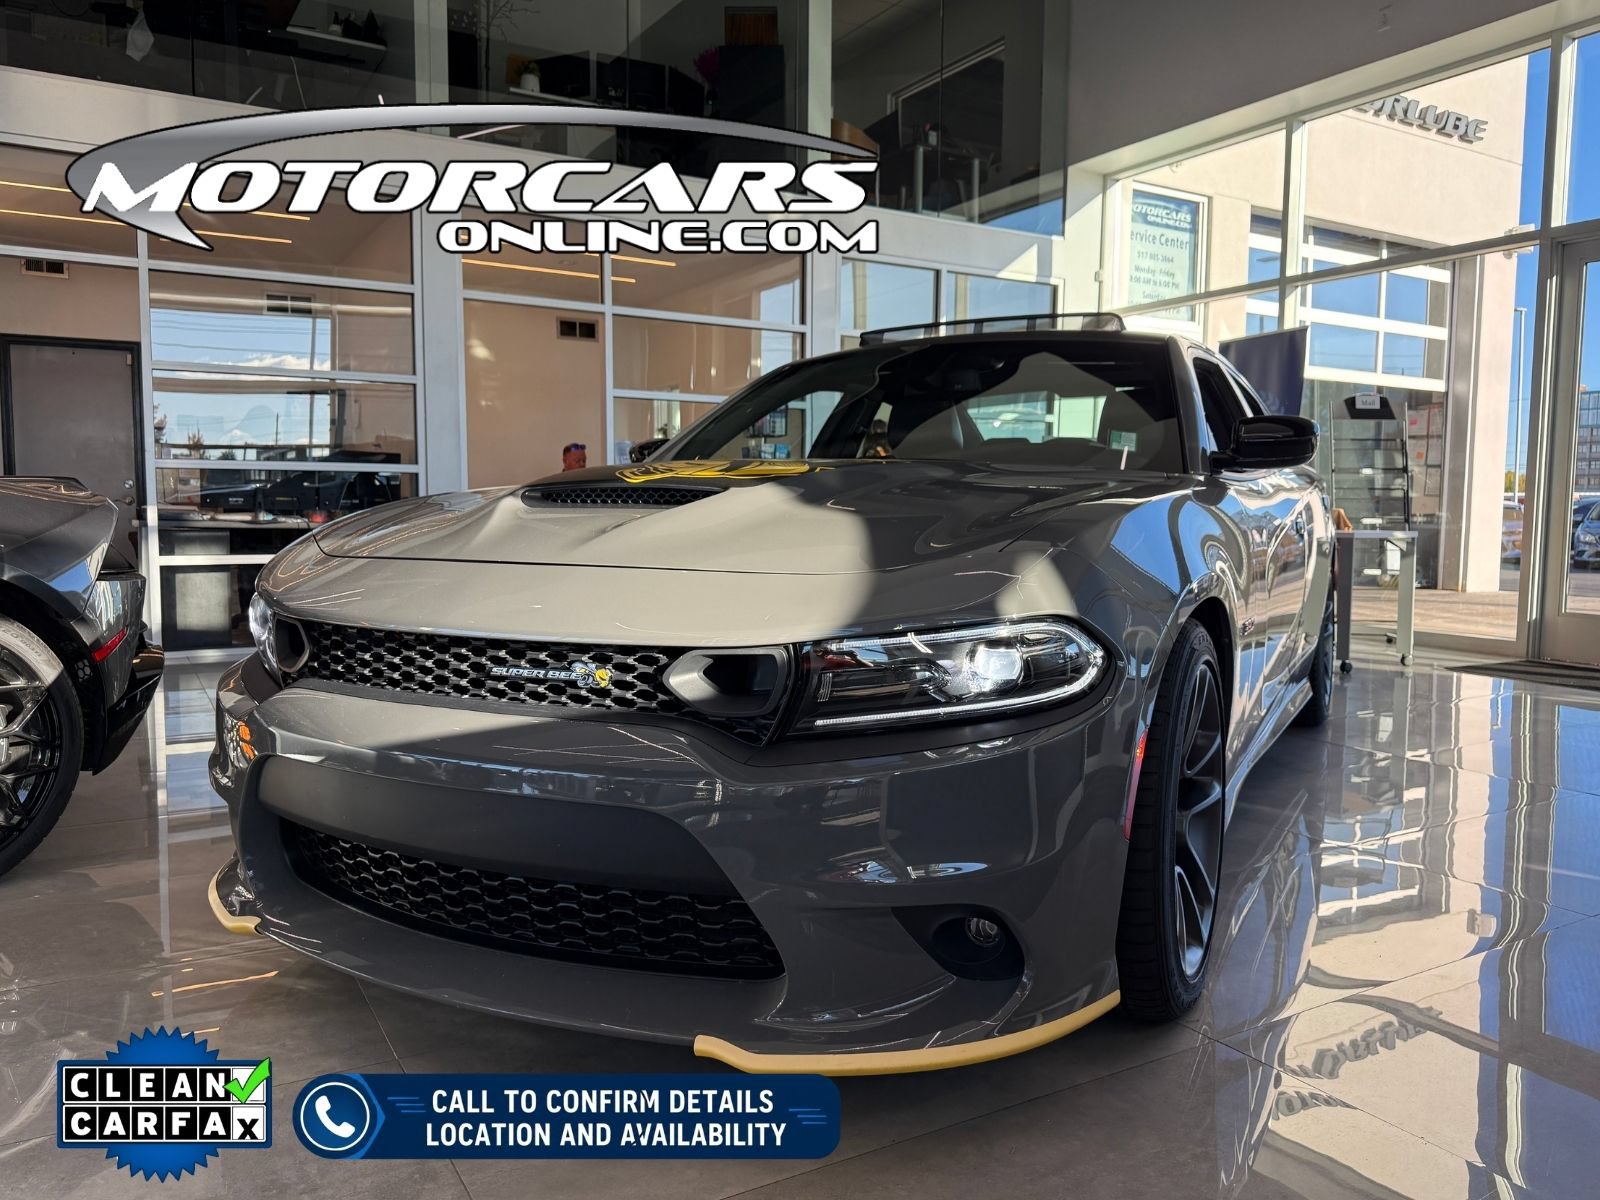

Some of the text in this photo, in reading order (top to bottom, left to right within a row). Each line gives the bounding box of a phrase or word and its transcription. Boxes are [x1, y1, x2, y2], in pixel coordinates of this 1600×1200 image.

[1133, 204, 1192, 223] OTORCARS
[1130, 229, 1189, 250] ervice Center
[1361, 399, 1376, 407] Mail
[490, 667, 583, 680] SUPER BEE
